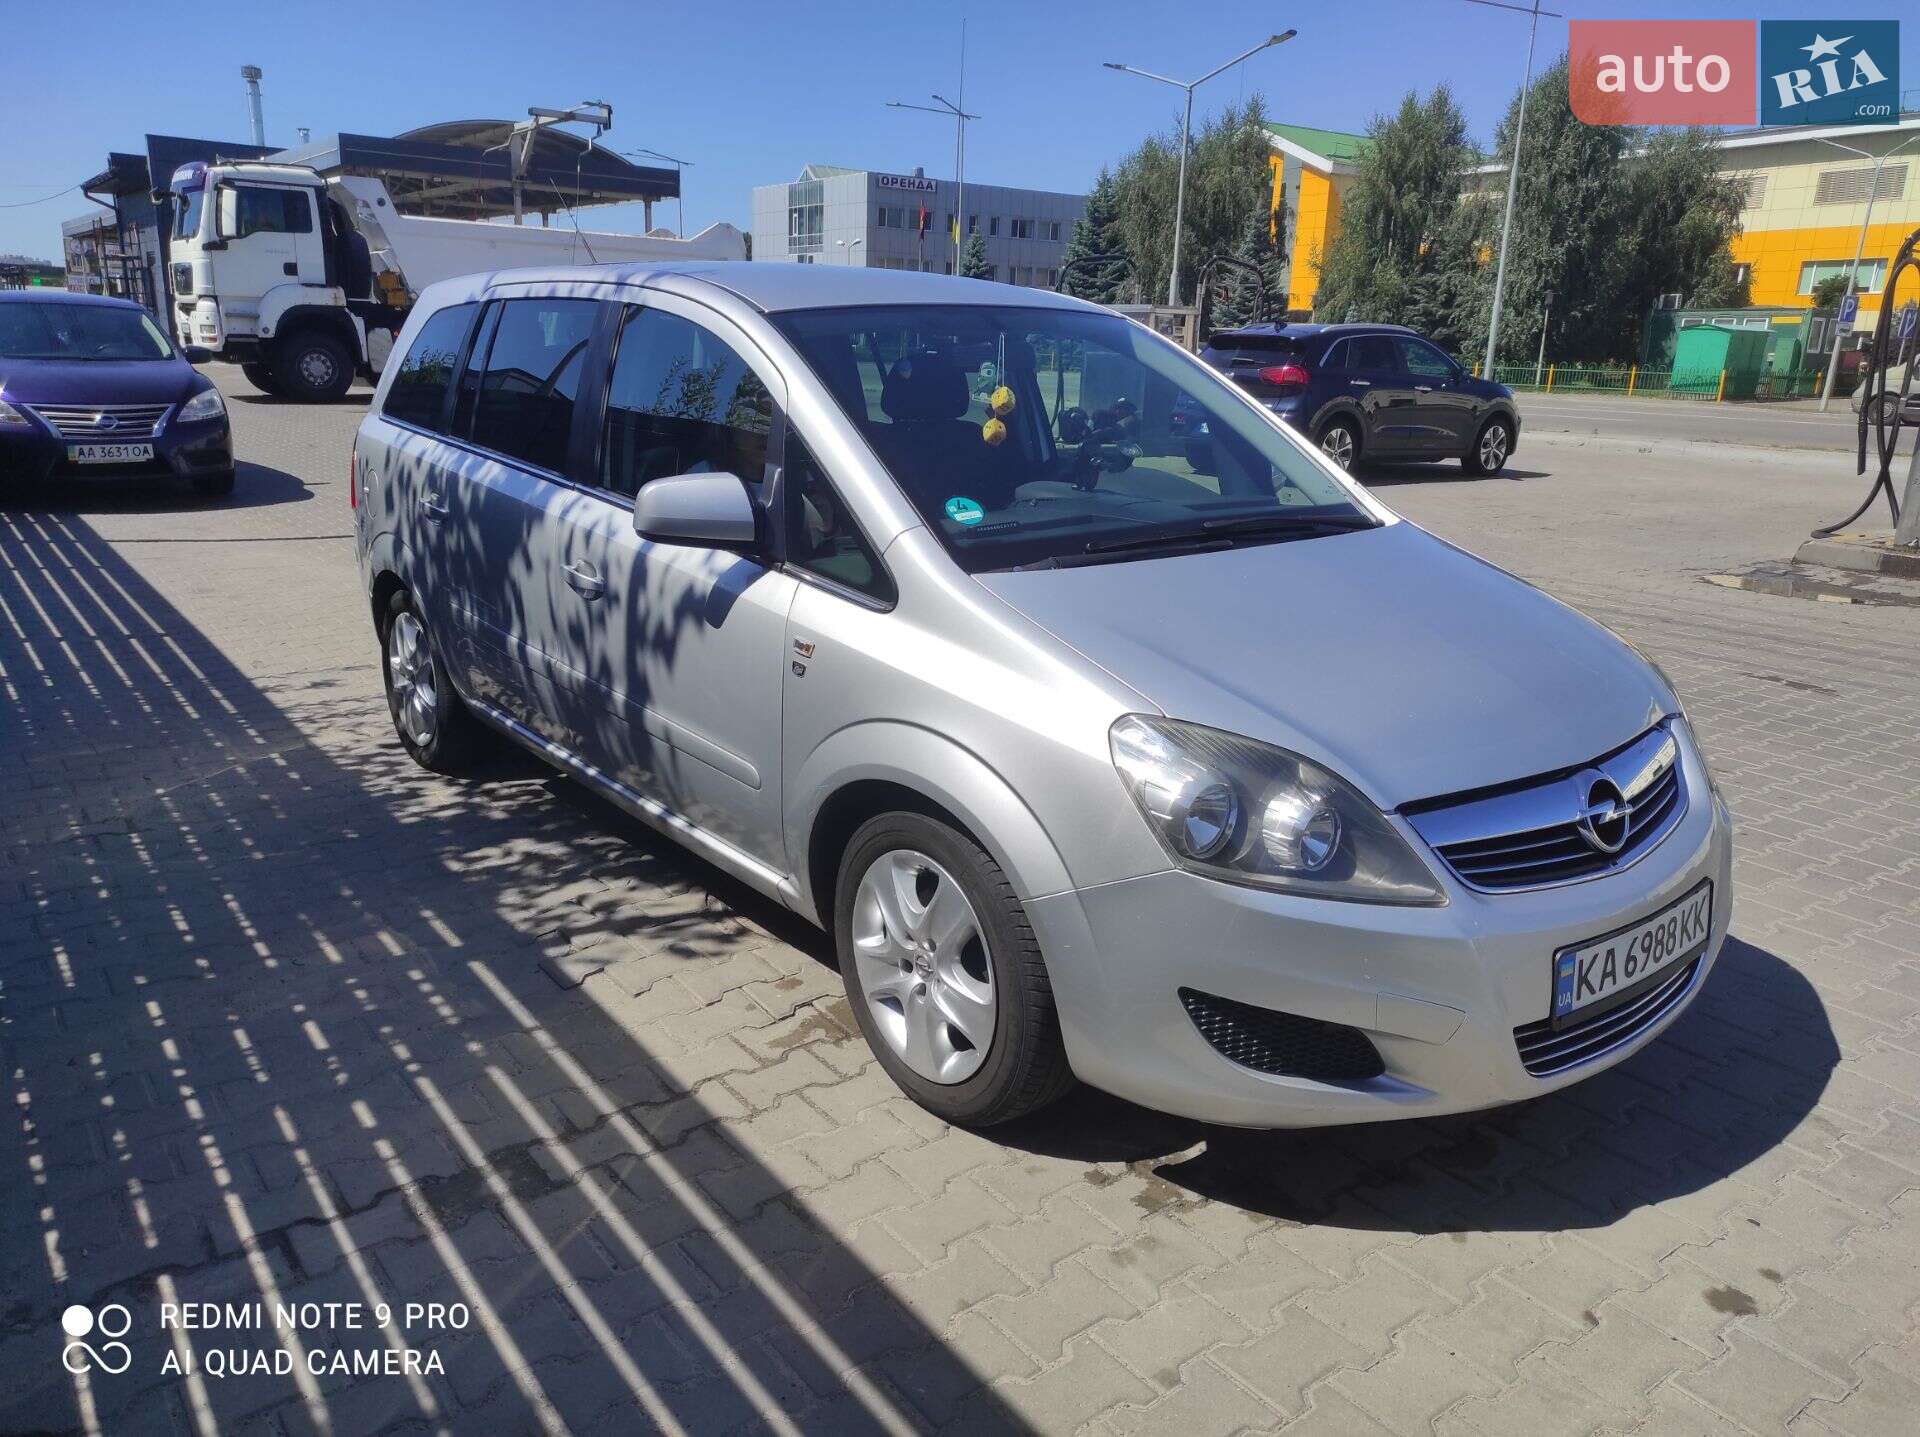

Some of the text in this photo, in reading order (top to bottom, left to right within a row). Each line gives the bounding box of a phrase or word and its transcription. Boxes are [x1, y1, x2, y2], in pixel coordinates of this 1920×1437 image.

[880, 176, 934, 190] ОРЕНДА
[1576, 947, 1617, 1001] KA
[1558, 992, 1573, 1007] UA
